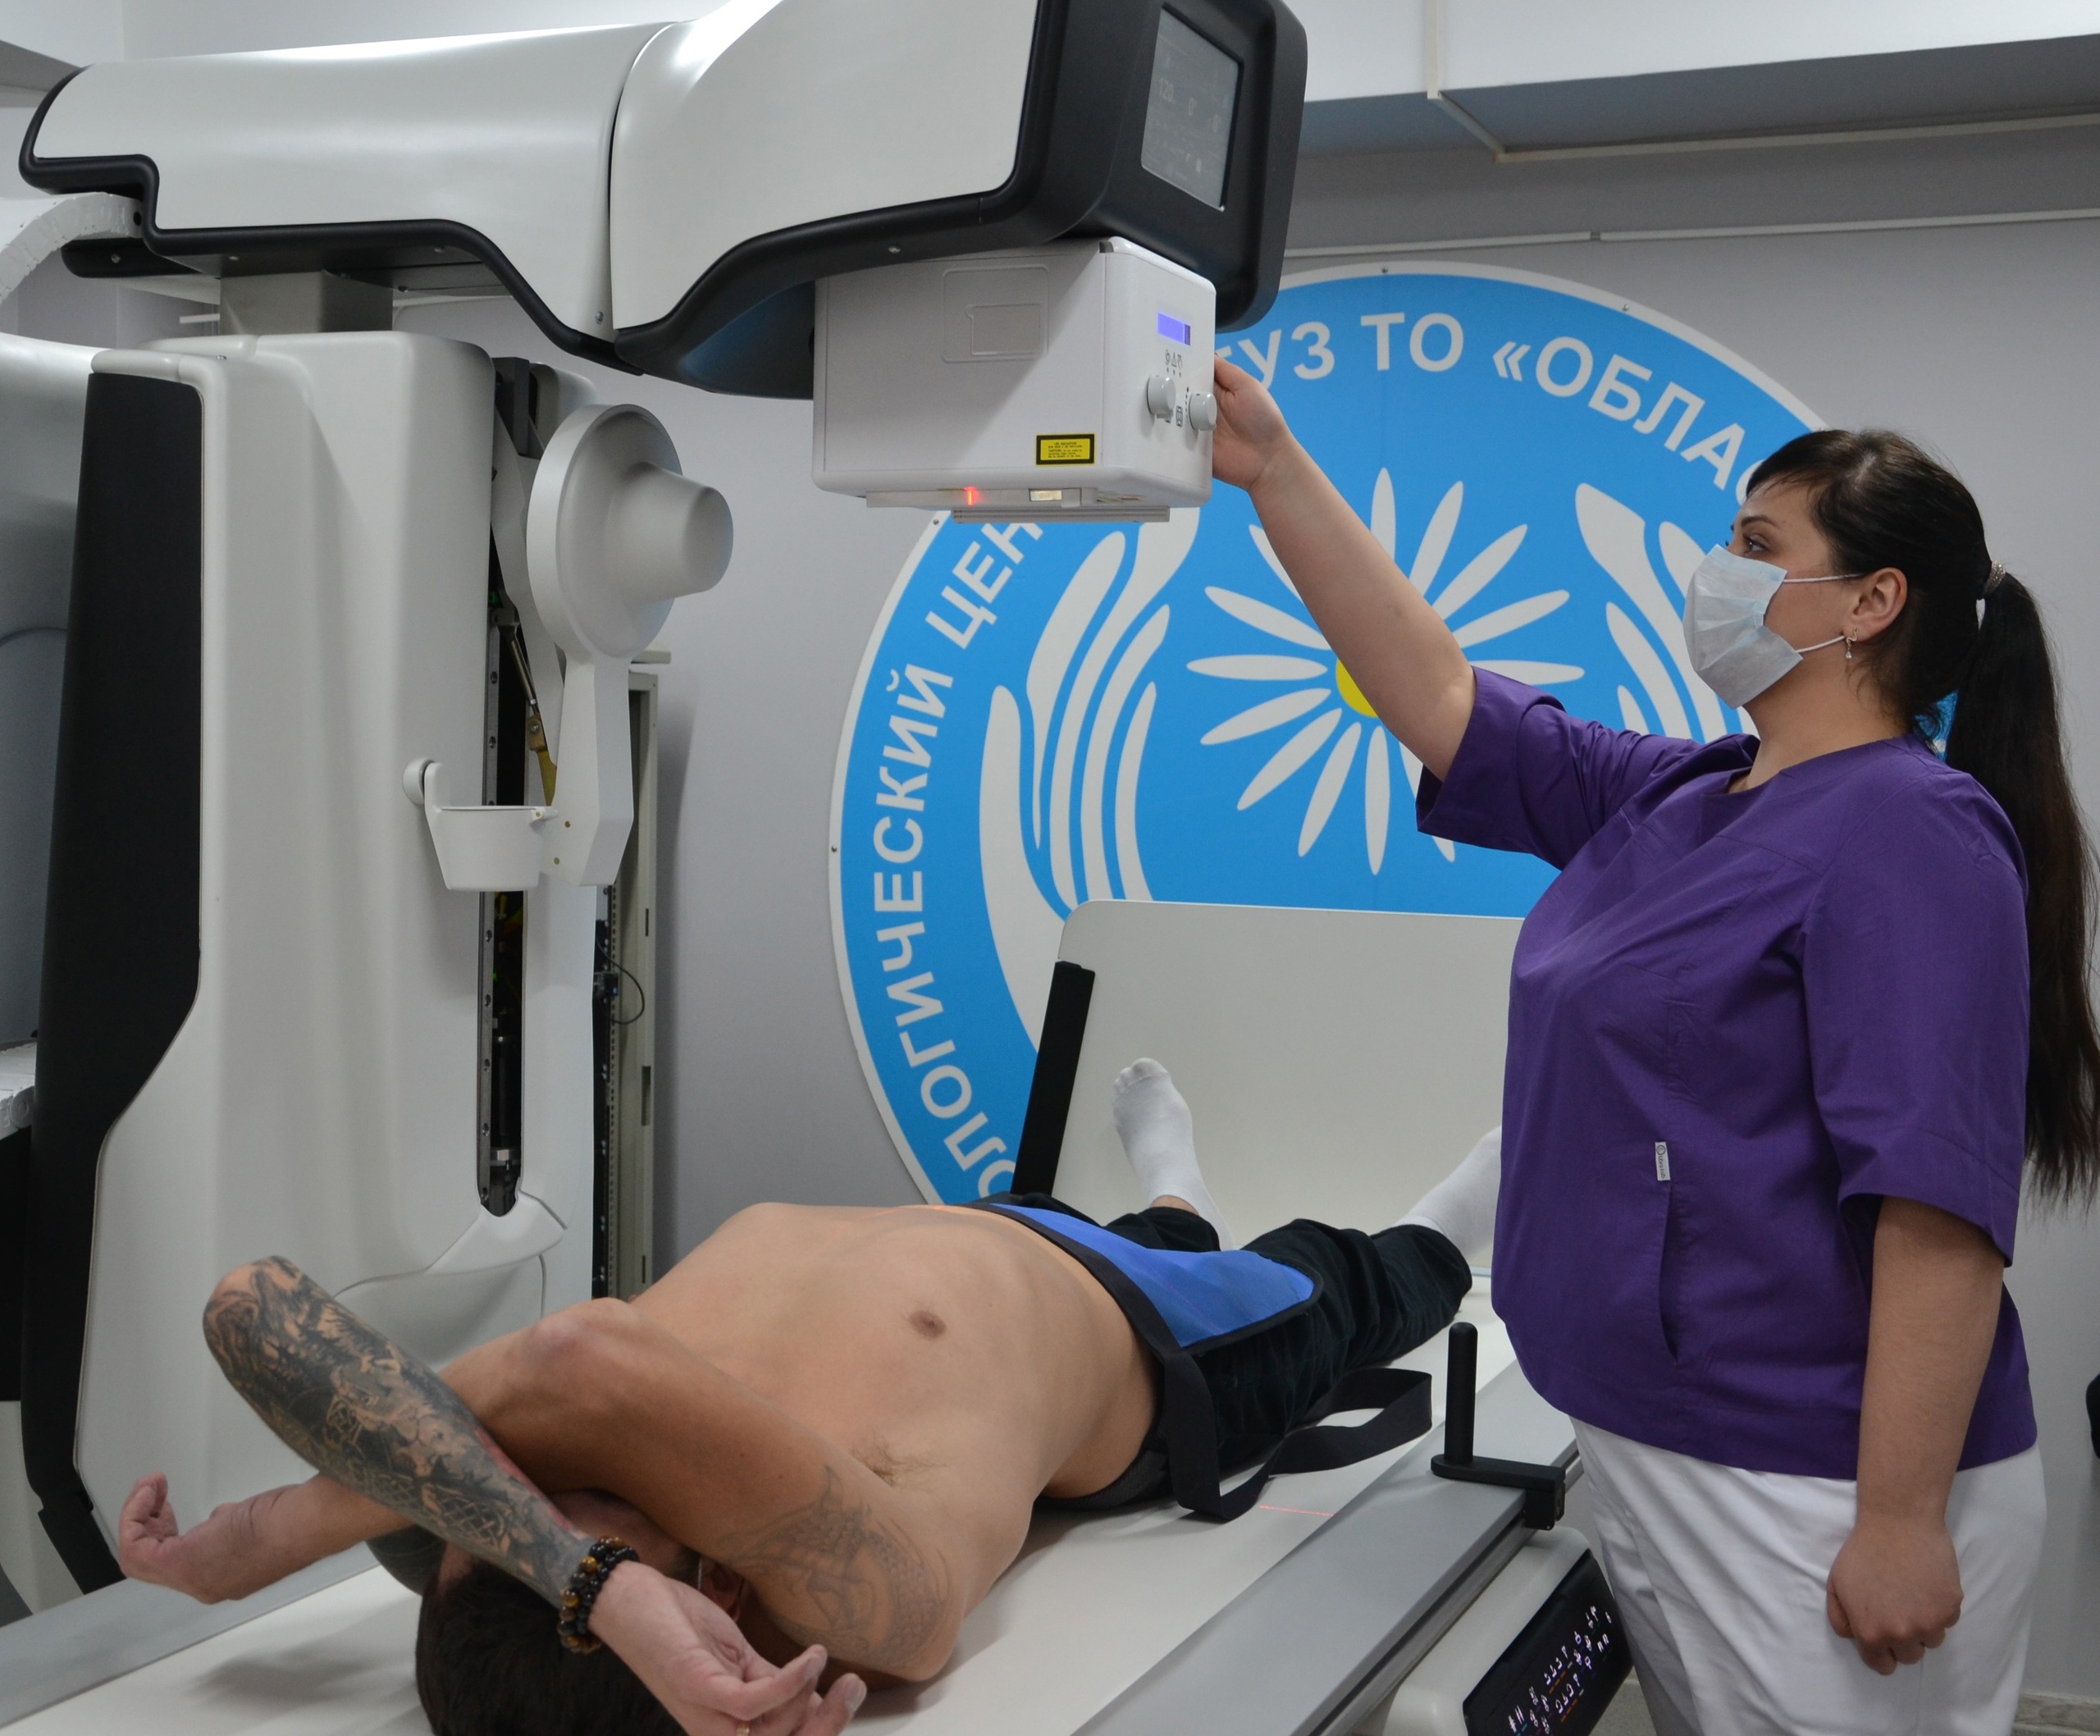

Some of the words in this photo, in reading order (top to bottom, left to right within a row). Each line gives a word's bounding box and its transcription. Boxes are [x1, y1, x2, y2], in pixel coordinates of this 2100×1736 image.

[1216, 321, 1335, 389] УЗ
[1360, 312, 1464, 372] ТО
[924, 523, 1043, 650] ЦЕН
